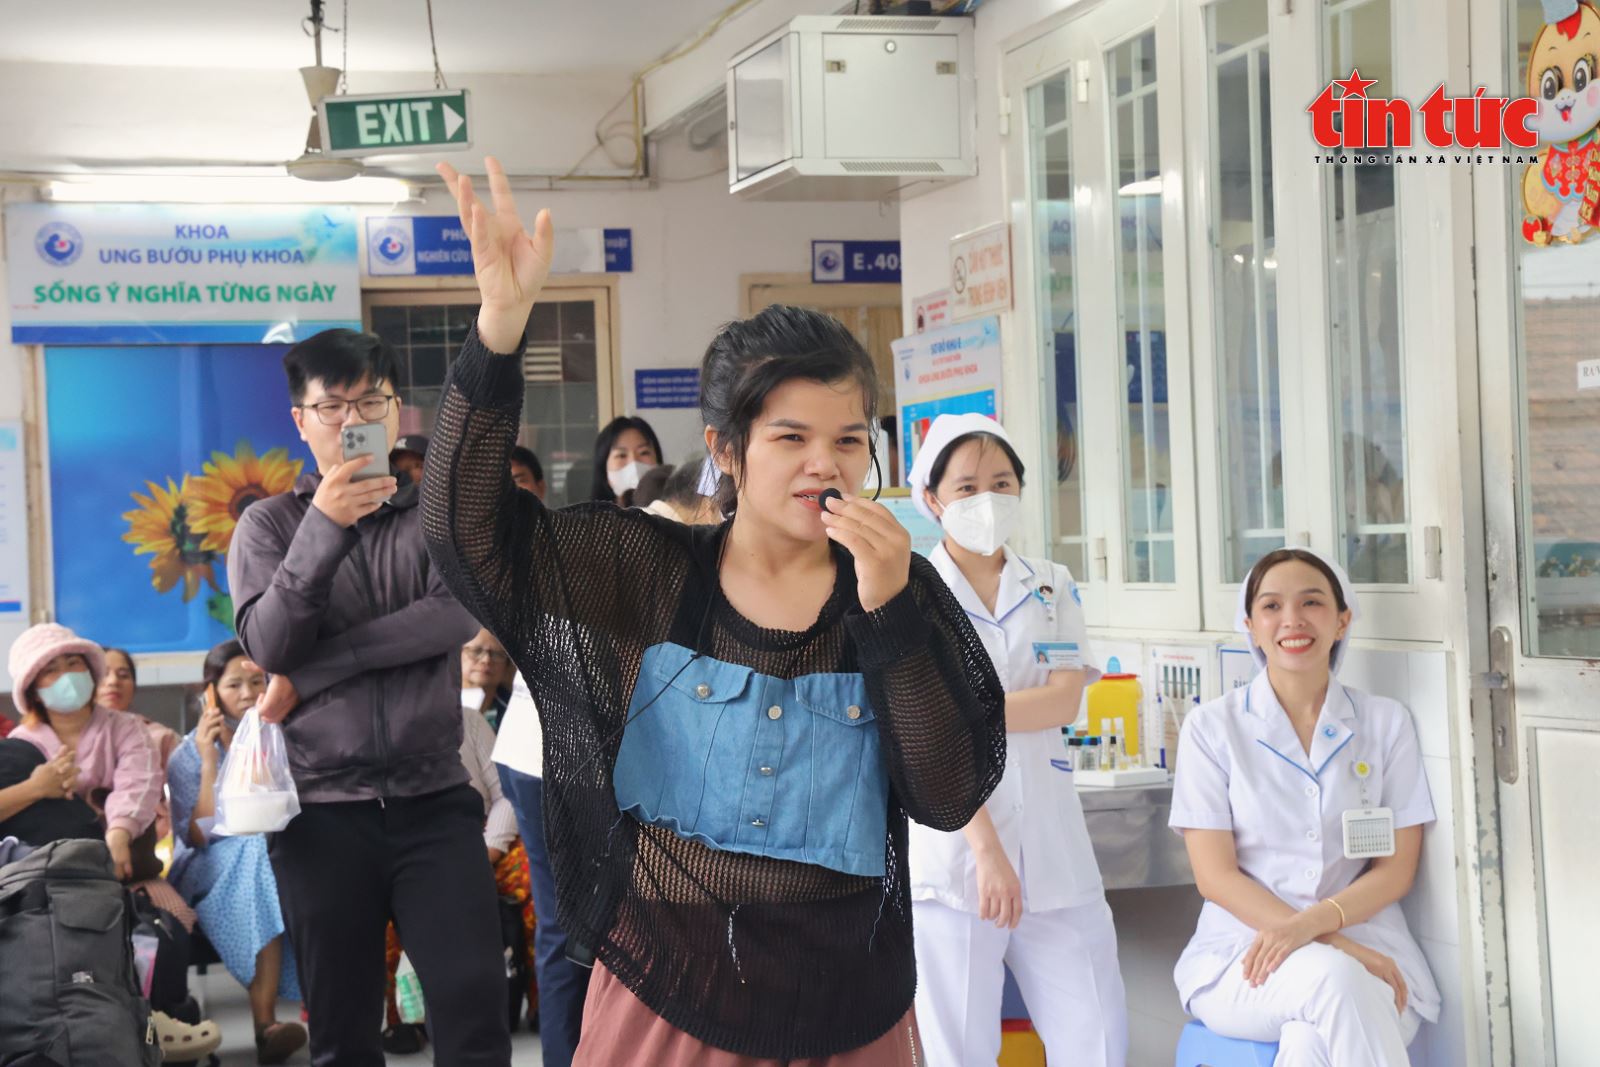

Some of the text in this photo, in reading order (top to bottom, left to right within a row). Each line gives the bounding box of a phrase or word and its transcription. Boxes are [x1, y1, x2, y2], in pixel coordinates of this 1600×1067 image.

[356, 101, 433, 145] EXIT
[175, 224, 229, 240] KHOA
[99, 246, 305, 268] UNG BƯỚU PHỤ KHOA
[853, 252, 902, 271] E.40
[34, 279, 336, 304] SỐNG Ý NGHĨA TỪNG NGÀY
